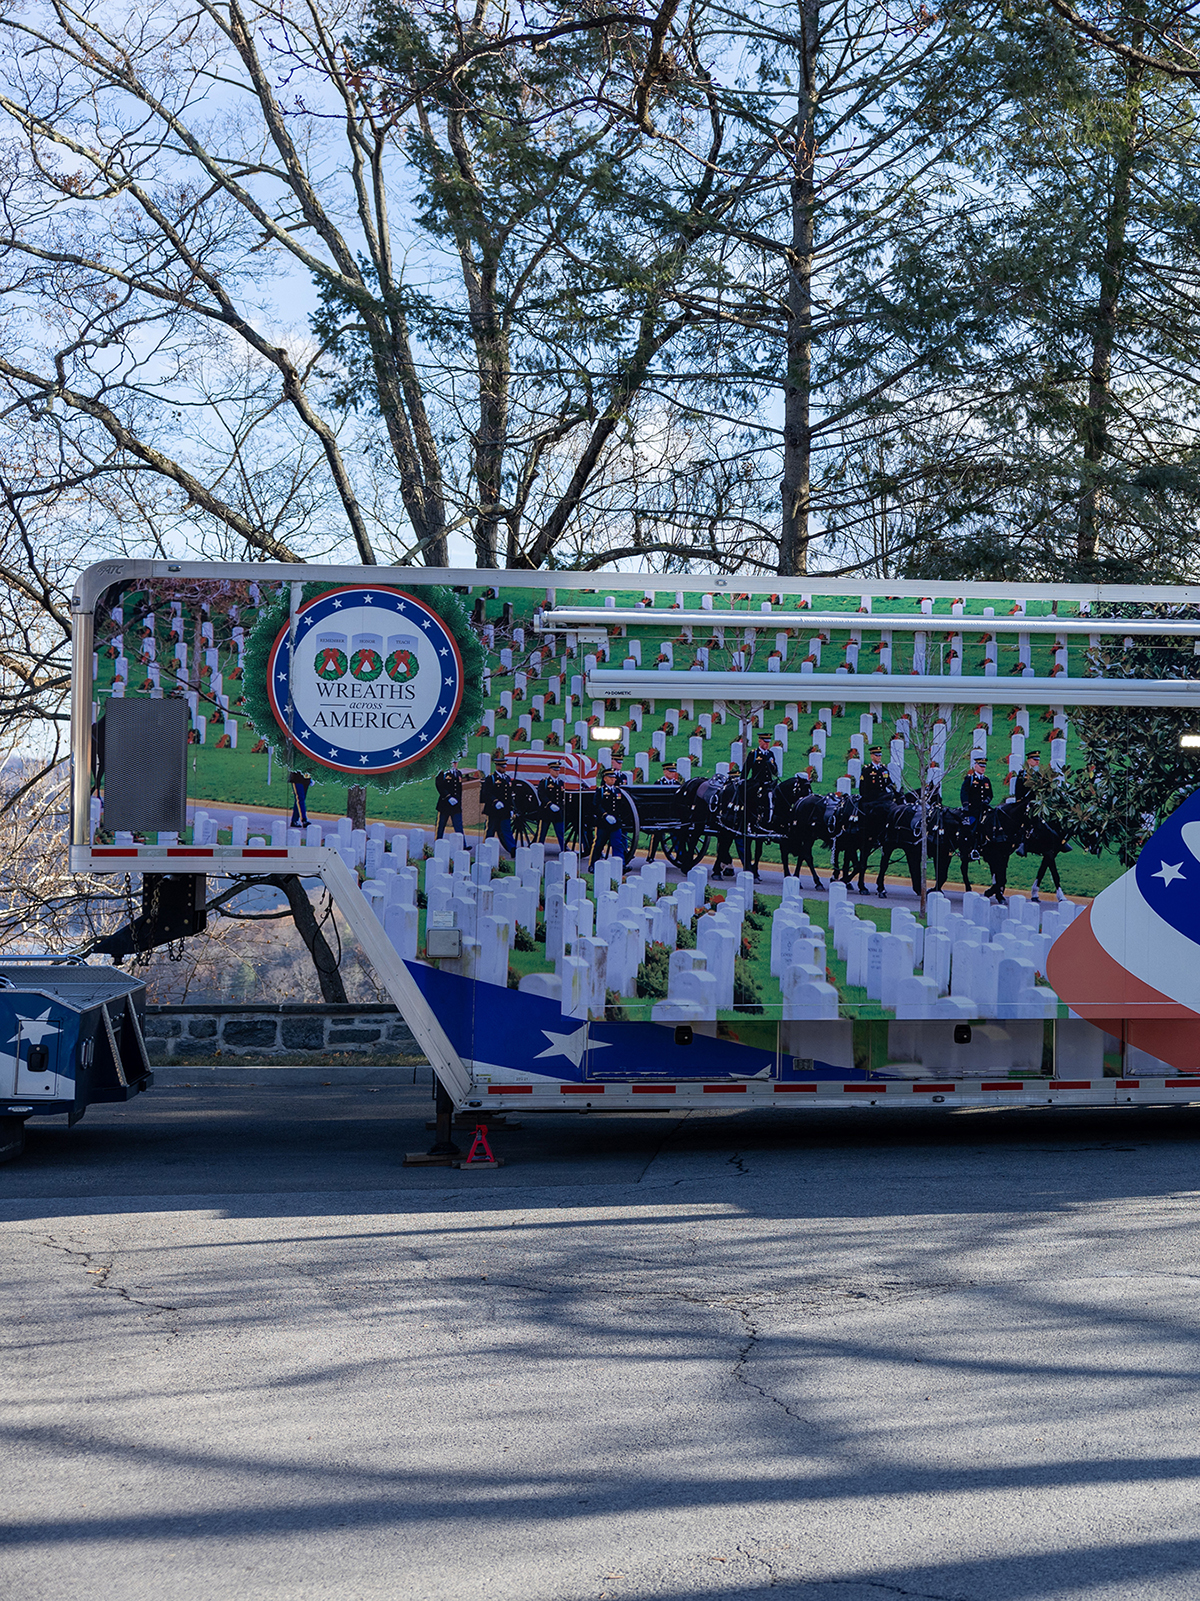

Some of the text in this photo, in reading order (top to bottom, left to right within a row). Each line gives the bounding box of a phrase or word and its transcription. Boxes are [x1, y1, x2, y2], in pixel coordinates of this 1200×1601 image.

[315, 682, 416, 700] WREATHS
[349, 701, 383, 710] across
[312, 711, 417, 729] AMERICA
